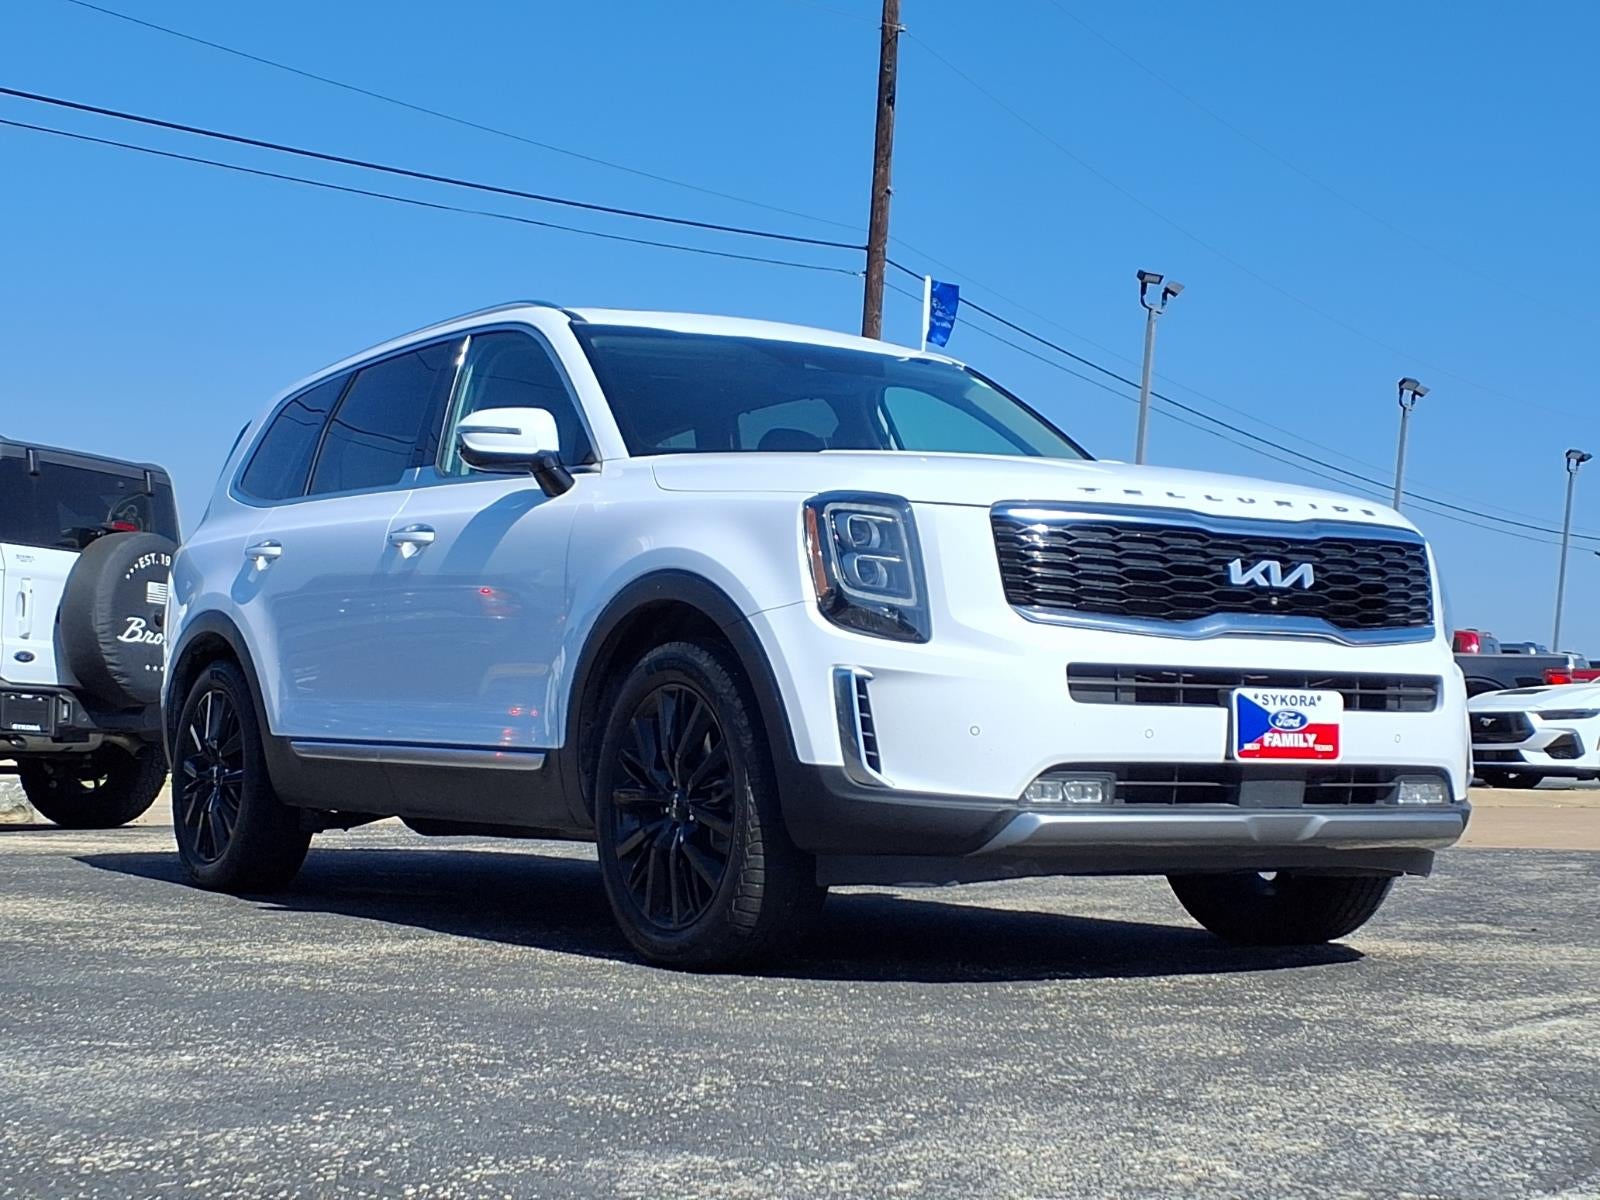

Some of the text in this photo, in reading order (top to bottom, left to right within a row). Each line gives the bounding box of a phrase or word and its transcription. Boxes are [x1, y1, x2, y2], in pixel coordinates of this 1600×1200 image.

[1077, 487, 1376, 517] TELLURIDE
[138, 552, 171, 569] EST. 19
[1228, 558, 1315, 589] KIA
[116, 616, 165, 645] Bro
[1261, 694, 1317, 707] SYKORA
[1275, 711, 1302, 727] Ford
[1262, 732, 1317, 748] FAMILY
